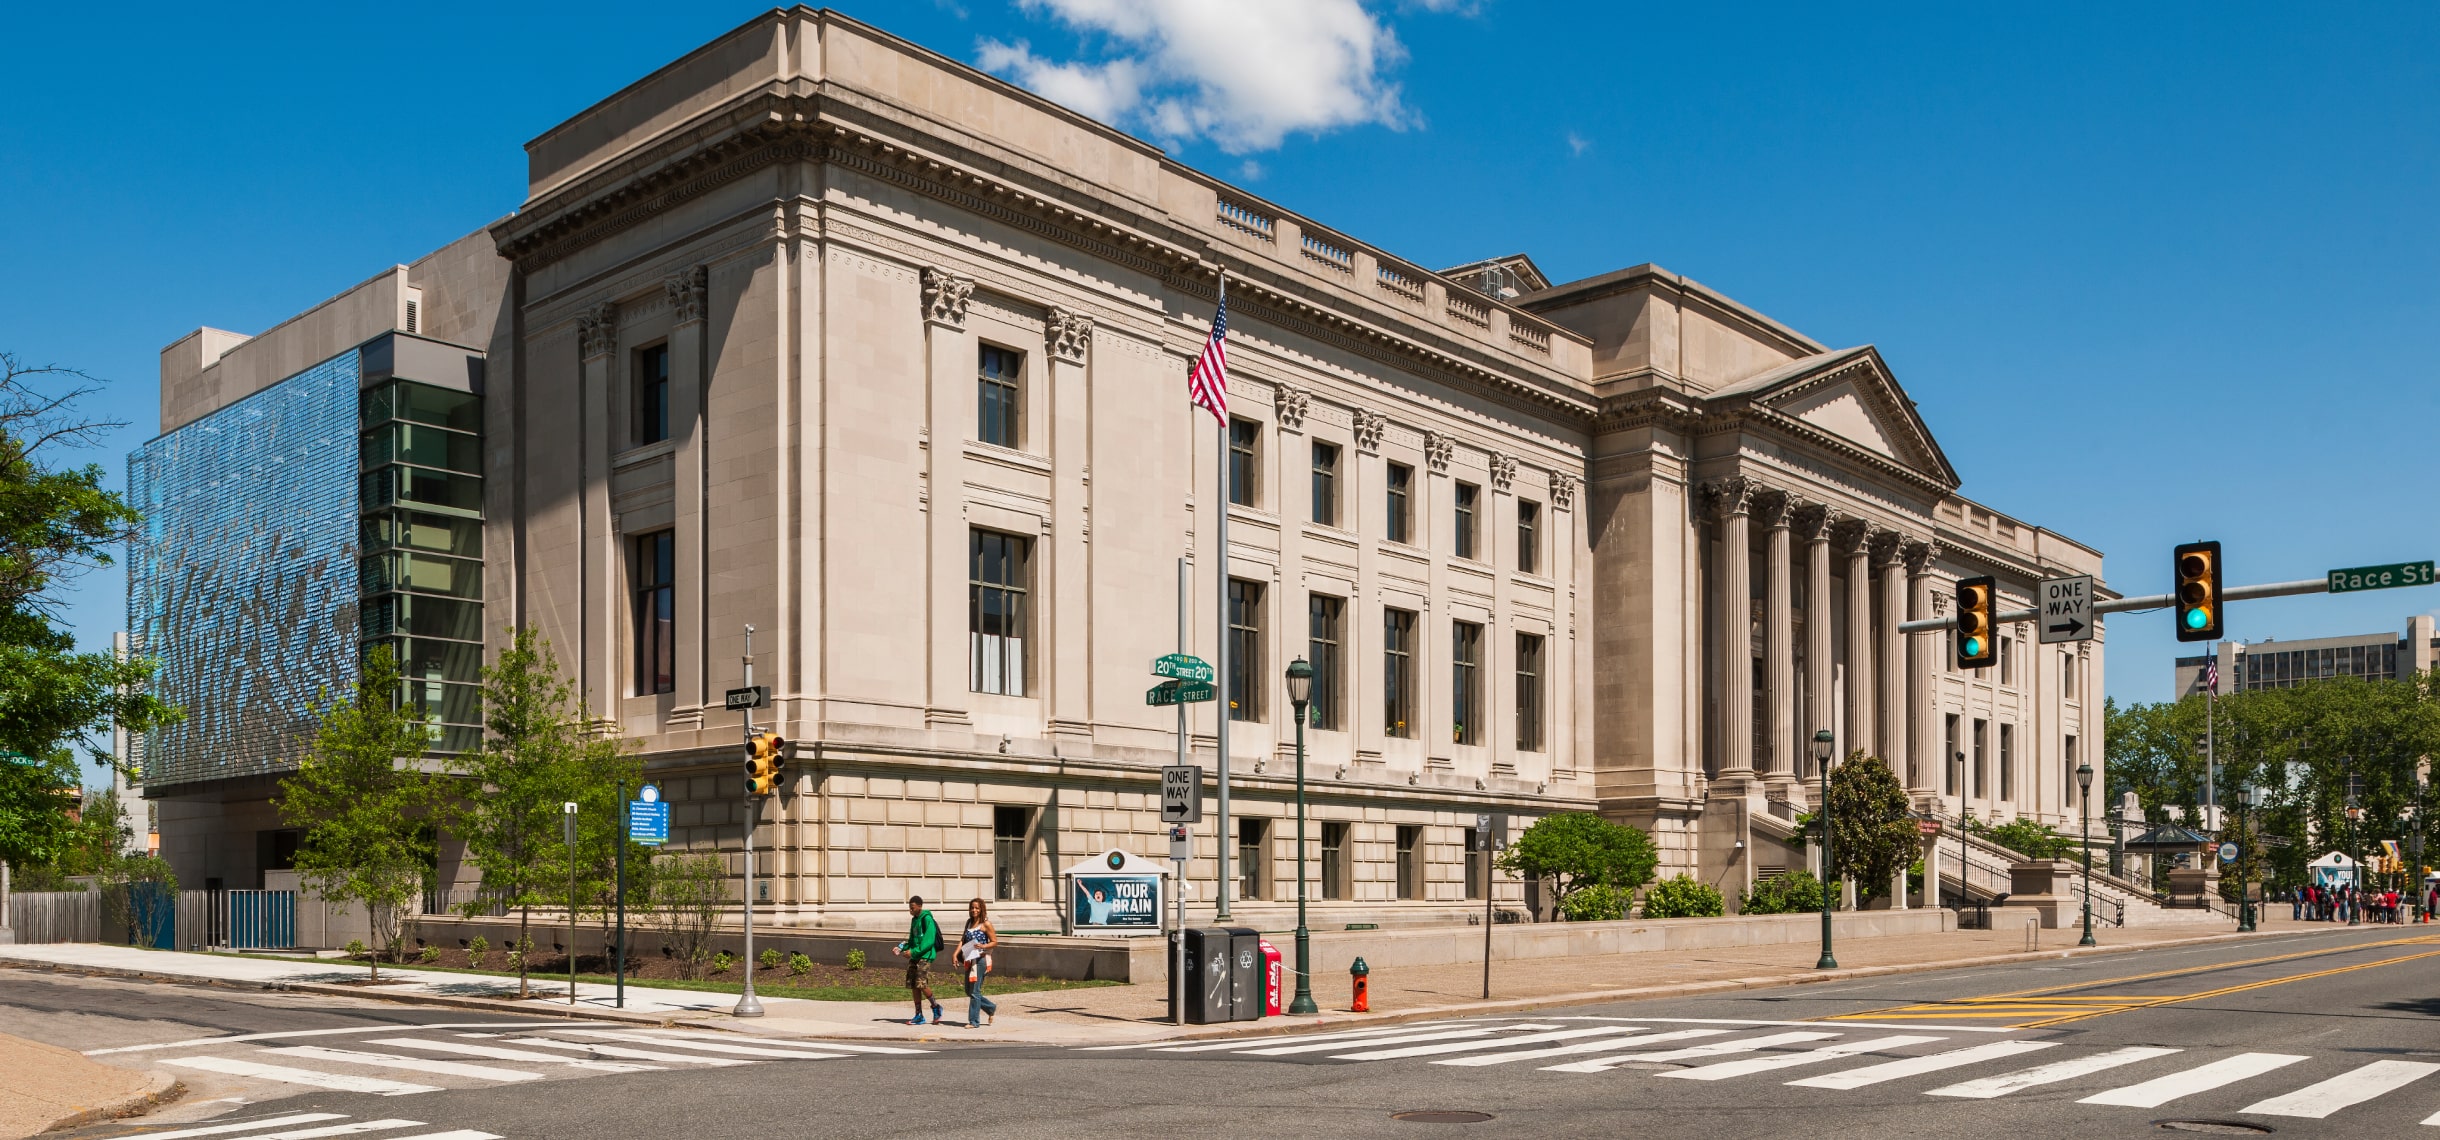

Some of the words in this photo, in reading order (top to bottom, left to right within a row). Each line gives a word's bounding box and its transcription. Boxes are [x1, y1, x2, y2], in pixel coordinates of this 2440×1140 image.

[2331, 571, 2392, 590] Race
[2402, 564, 2429, 583] St
[2050, 582, 2082, 599] ONE
[2049, 599, 2084, 616] WAY
[1176, 667, 1195, 678] STREET
[730, 695, 740, 704] ONE
[1149, 690, 1176, 704] RACE
[1183, 690, 1208, 701] STREET
[1167, 771, 1190, 784] ONE
[1166, 786, 1190, 799] WAY
[1115, 883, 1149, 898] YOUR
[1112, 898, 1152, 913] BRAIN
[1269, 988, 1276, 1008] AL
